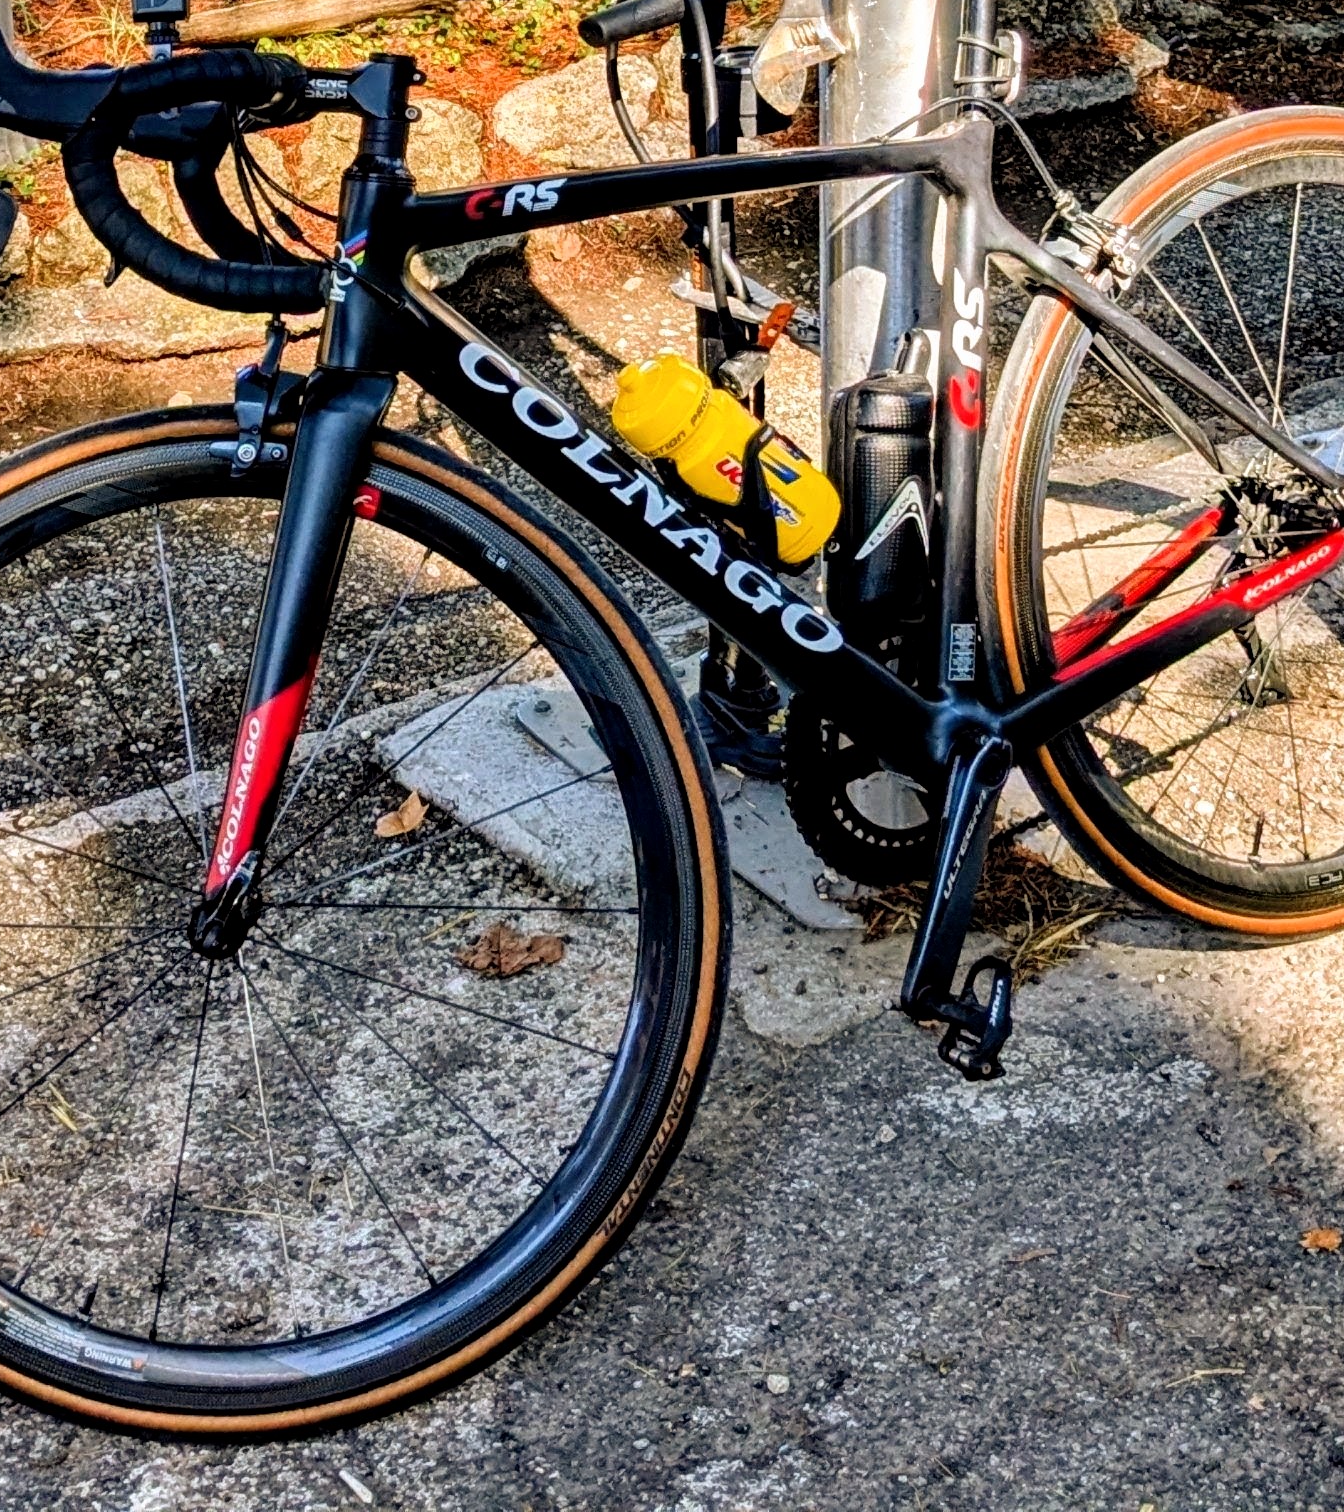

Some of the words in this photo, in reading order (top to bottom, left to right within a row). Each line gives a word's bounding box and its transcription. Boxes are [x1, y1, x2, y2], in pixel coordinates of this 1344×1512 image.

[459, 343, 843, 652] COLNAGO
[1251, 545, 1331, 598] COLNAGO
[219, 716, 261, 862] COLNAGO
[85, 1347, 132, 1368] WARNING
